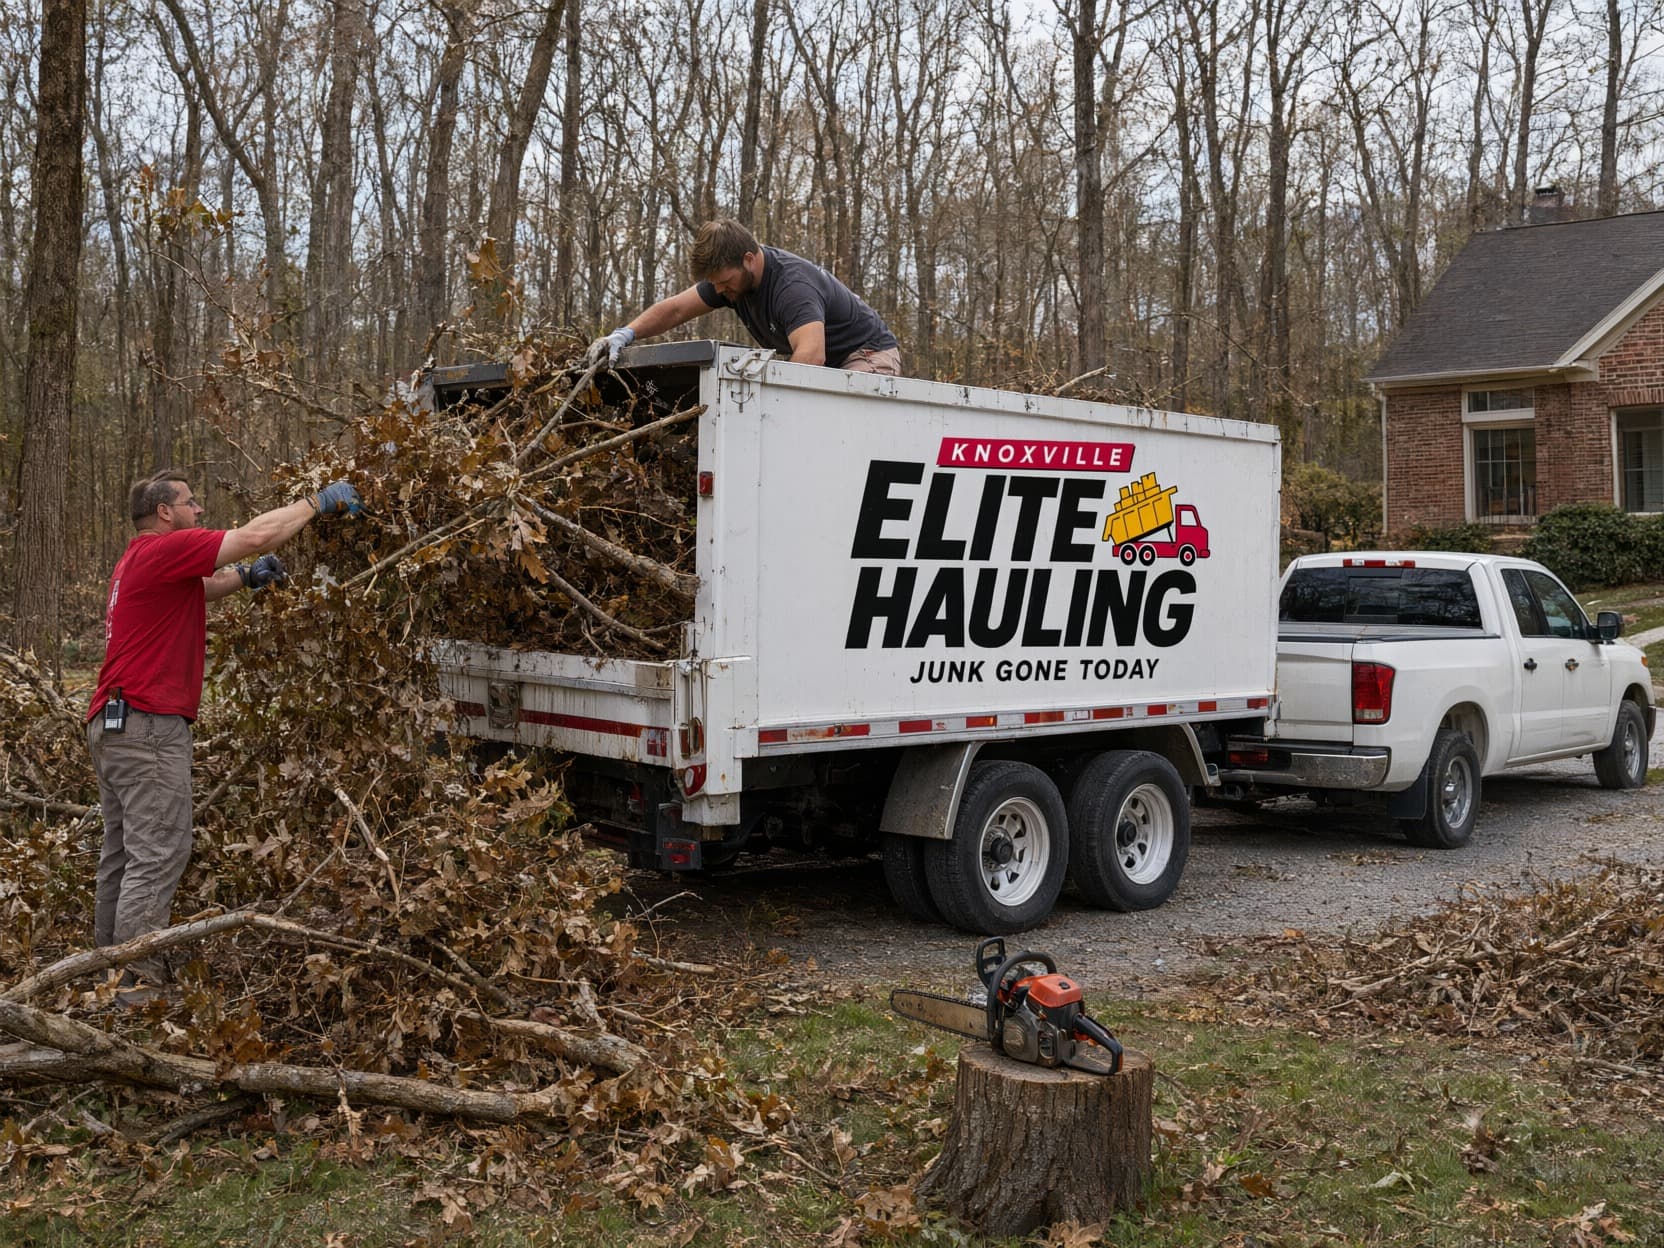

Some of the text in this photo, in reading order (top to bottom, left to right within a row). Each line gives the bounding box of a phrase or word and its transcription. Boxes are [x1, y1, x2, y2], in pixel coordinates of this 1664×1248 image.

[951, 442, 1123, 466] KNOXVILLE
[850, 459, 1107, 563] ELITE
[844, 566, 1197, 650] HAULING
[909, 658, 1160, 684] JUNK GONE TODAY
